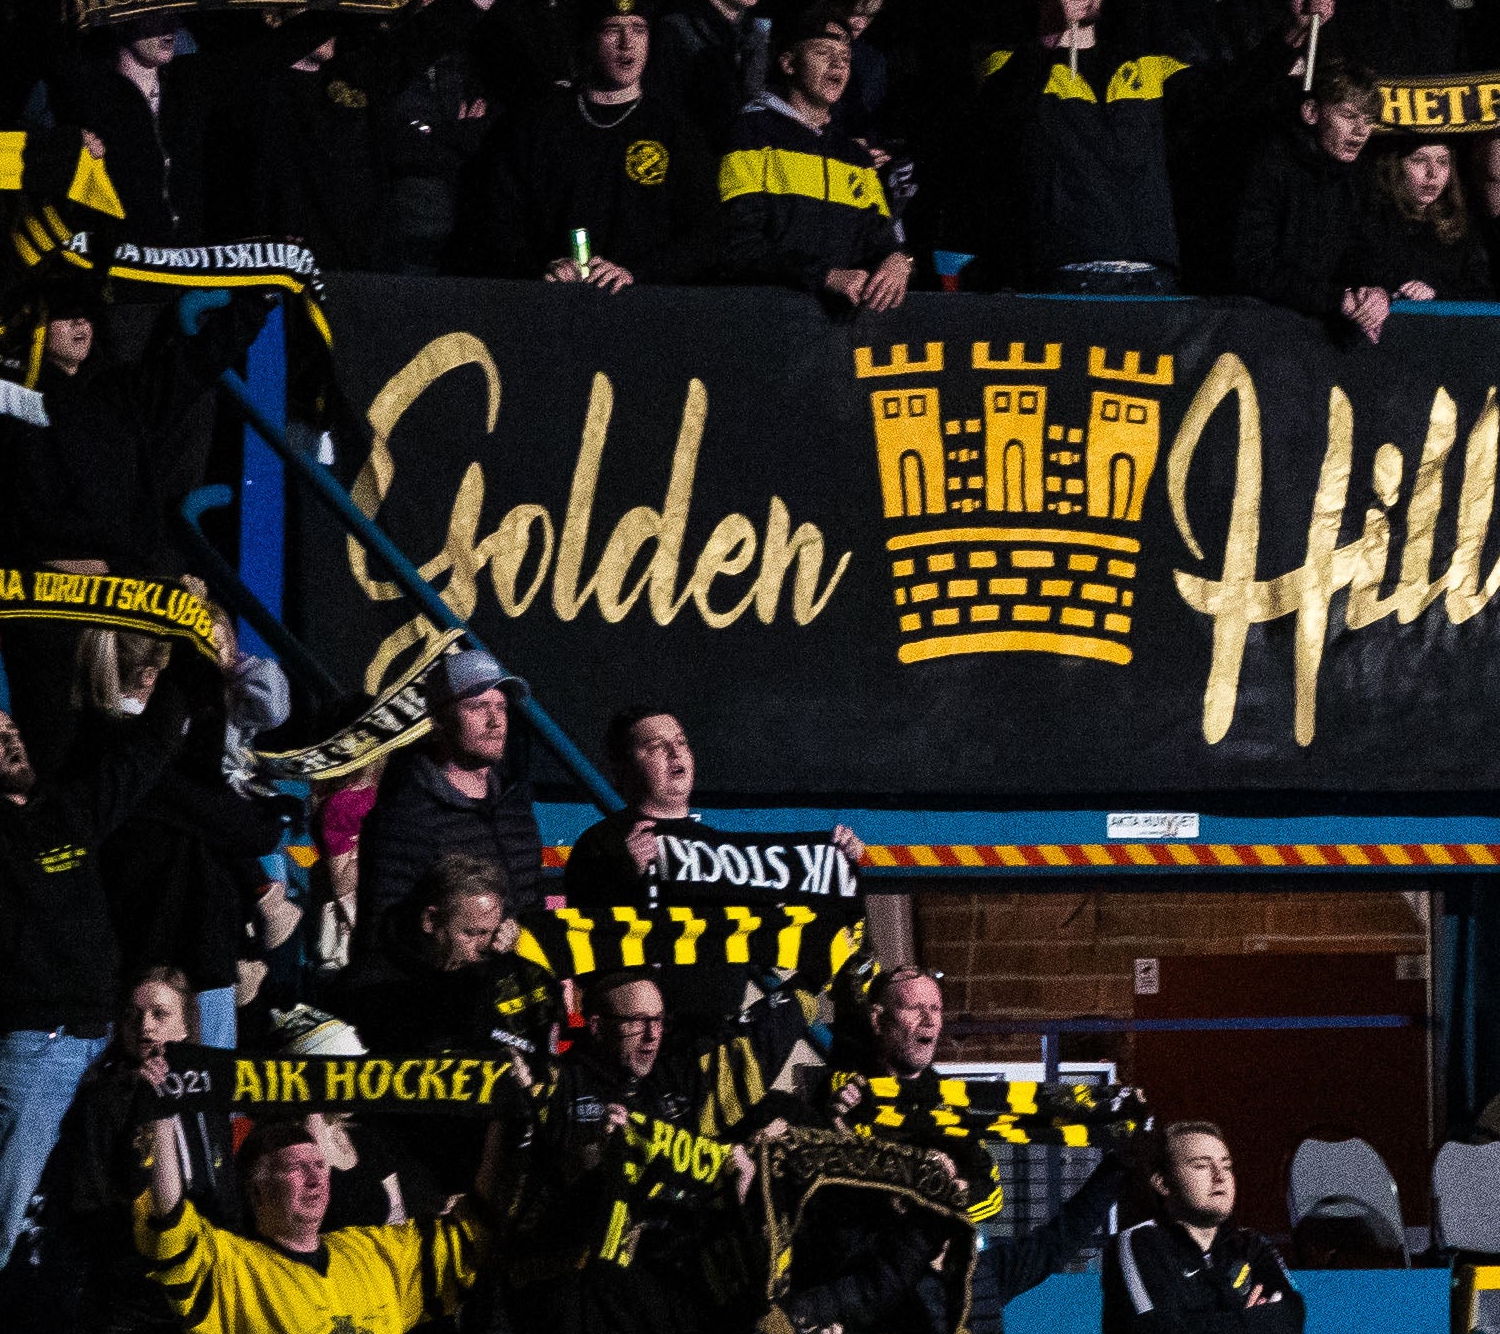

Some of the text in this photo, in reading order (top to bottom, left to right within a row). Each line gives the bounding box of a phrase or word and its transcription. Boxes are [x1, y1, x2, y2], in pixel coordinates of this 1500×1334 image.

[346, 329, 851, 698] Golden
[233, 1058, 313, 1103] AIK
[324, 1060, 508, 1106] HOCKEY
